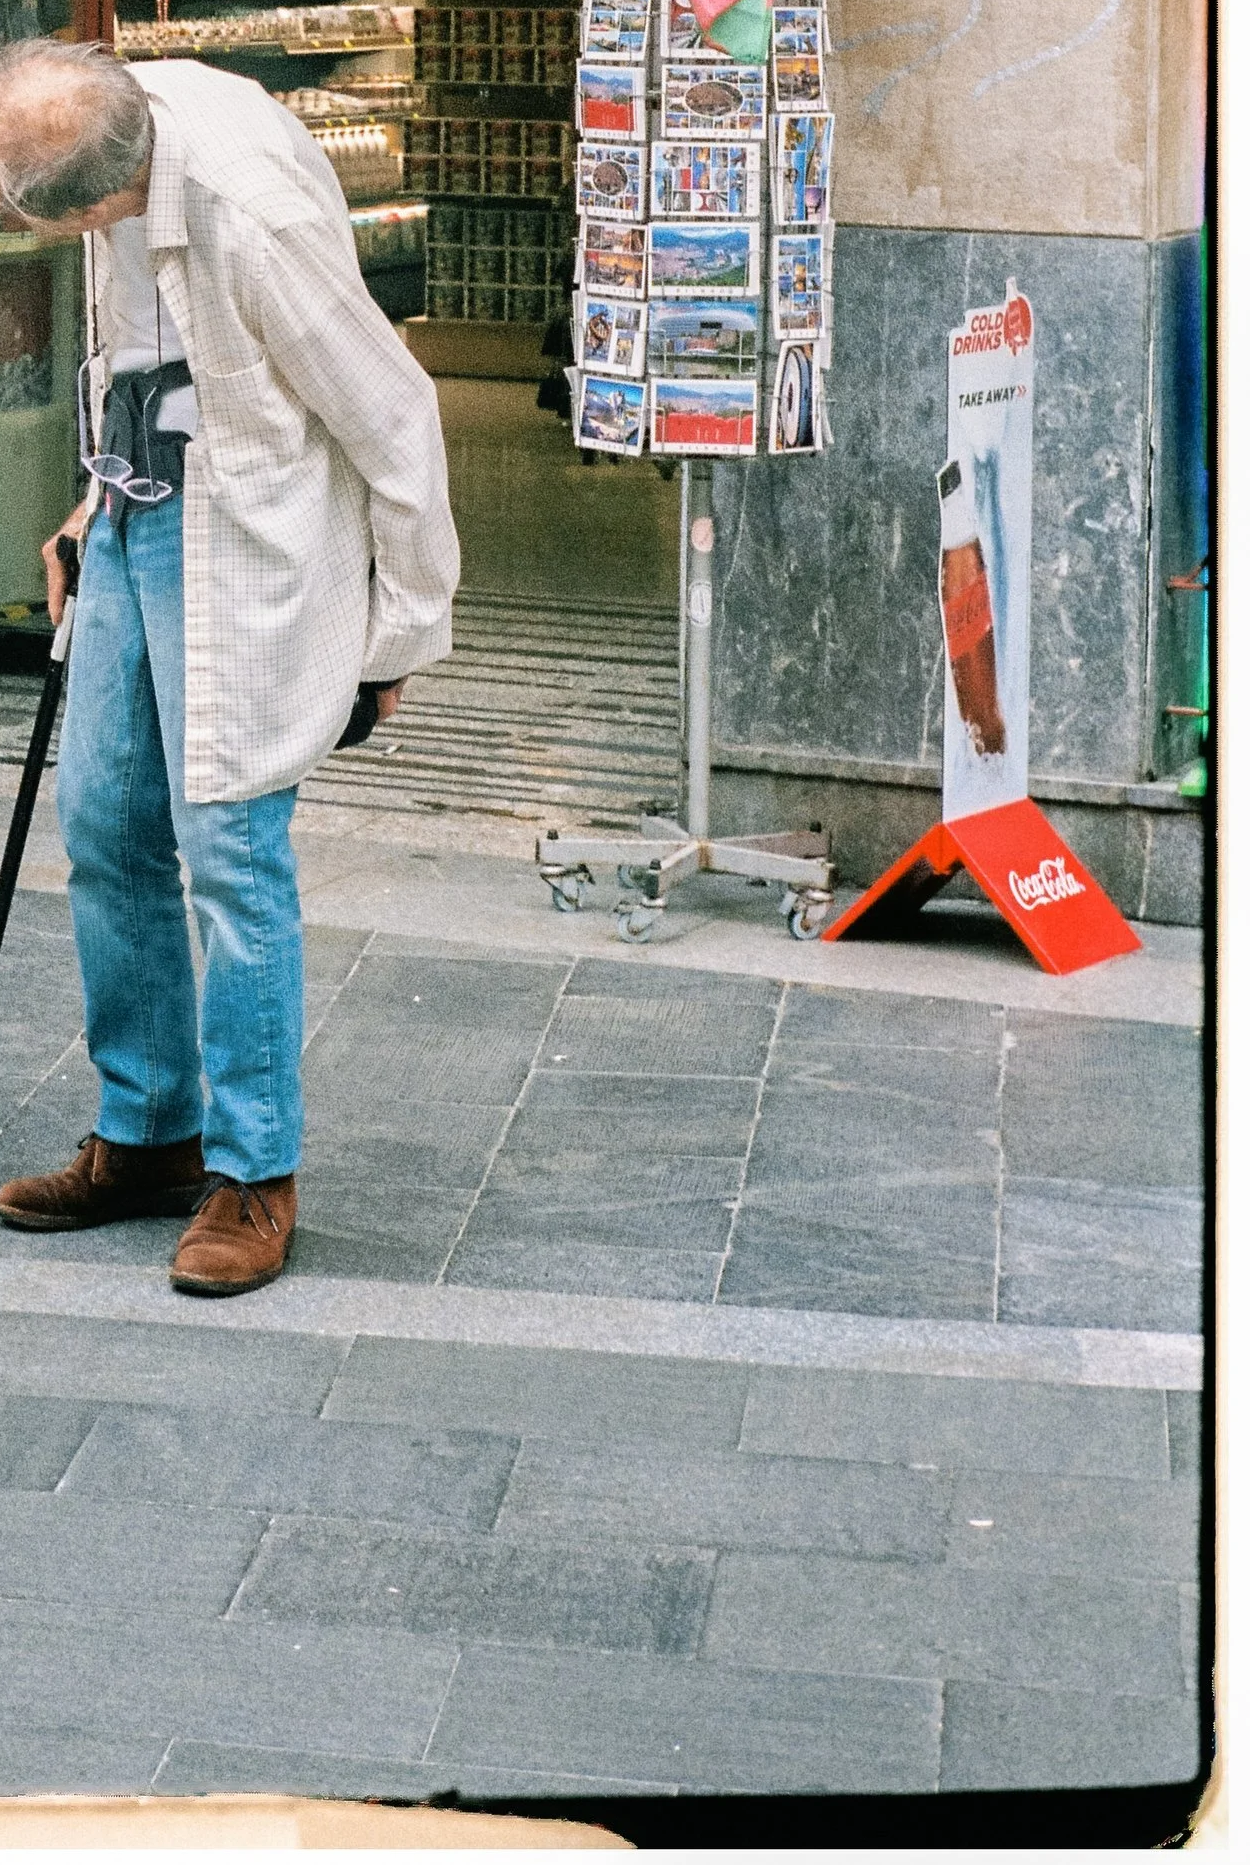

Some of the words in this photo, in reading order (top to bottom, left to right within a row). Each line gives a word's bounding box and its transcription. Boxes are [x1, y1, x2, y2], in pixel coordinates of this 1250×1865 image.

[970, 311, 1004, 333] COLD
[953, 331, 1003, 356] DRINKS
[958, 390, 985, 409] TAKE
[984, 385, 1017, 404] AWAY
